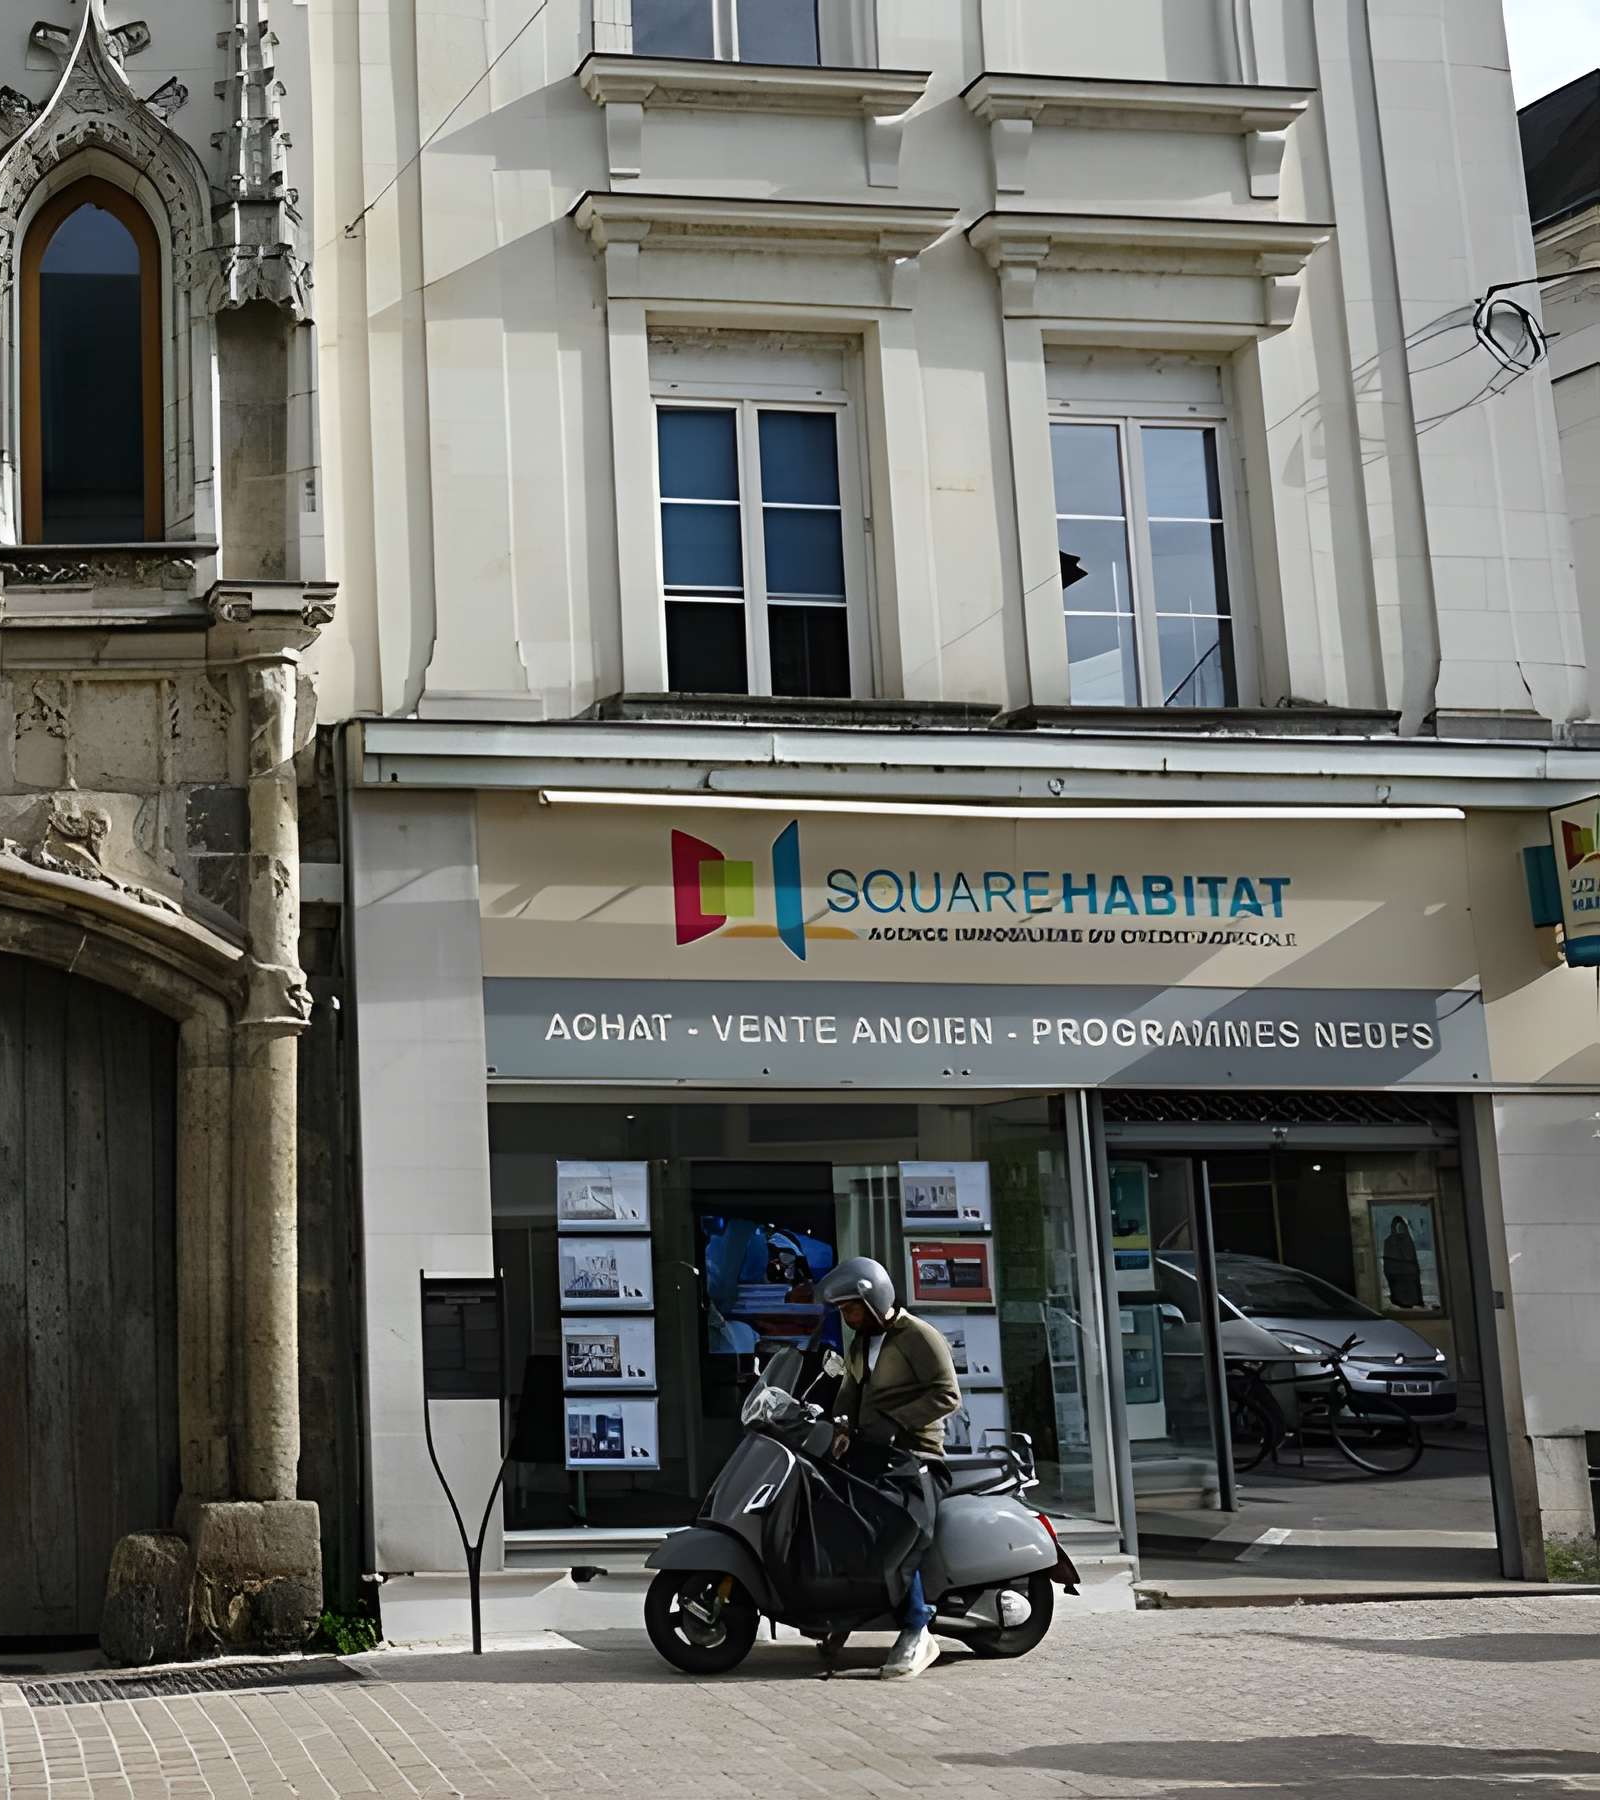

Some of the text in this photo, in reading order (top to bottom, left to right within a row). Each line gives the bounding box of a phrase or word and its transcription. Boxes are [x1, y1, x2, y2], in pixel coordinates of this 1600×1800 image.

[544, 1013, 672, 1041] ACHAT
[712, 1014, 838, 1043] VENTE
[852, 1016, 993, 1045] ANCIEN
[1032, 1018, 1300, 1048] PROGRAMMES
[1314, 1021, 1434, 1050] NEUFS
